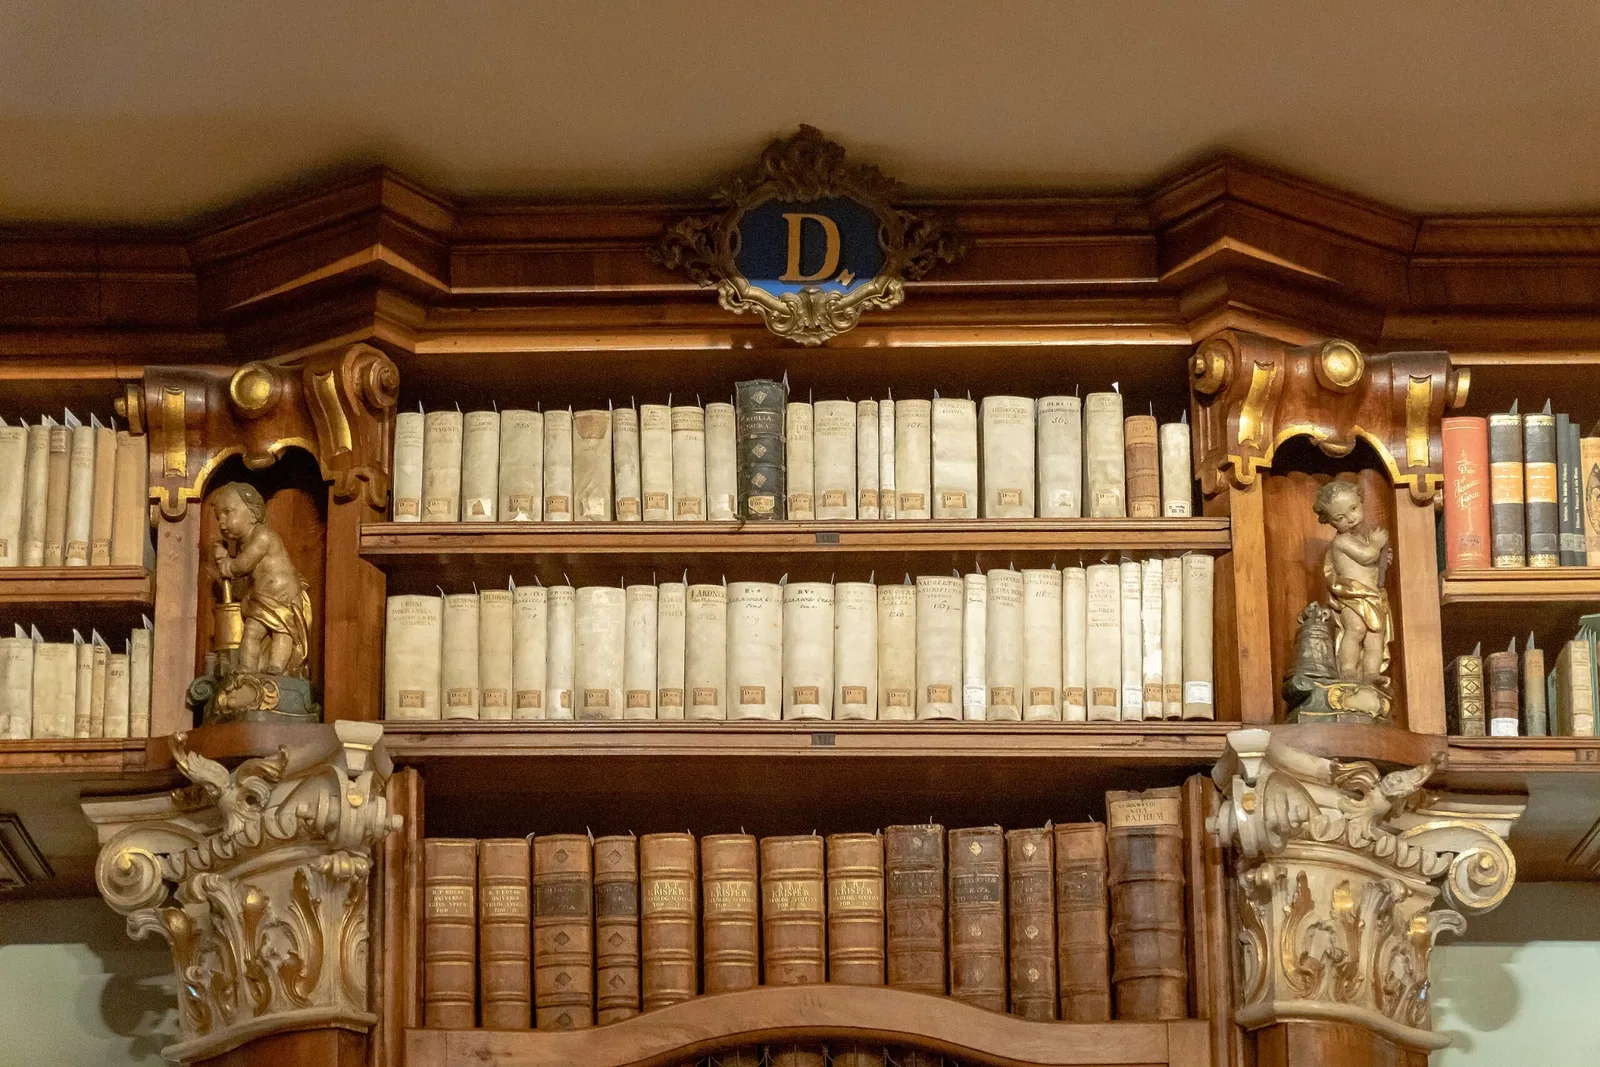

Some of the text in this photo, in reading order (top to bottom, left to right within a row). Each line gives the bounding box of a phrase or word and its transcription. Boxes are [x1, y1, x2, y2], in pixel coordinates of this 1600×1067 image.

[1125, 812, 1164, 822] PATRUM
[647, 888, 685, 896] KRISPER
[710, 888, 748, 897] KRISPER
[772, 888, 810, 897] KRISPER
[835, 887, 873, 895] KRISPER
